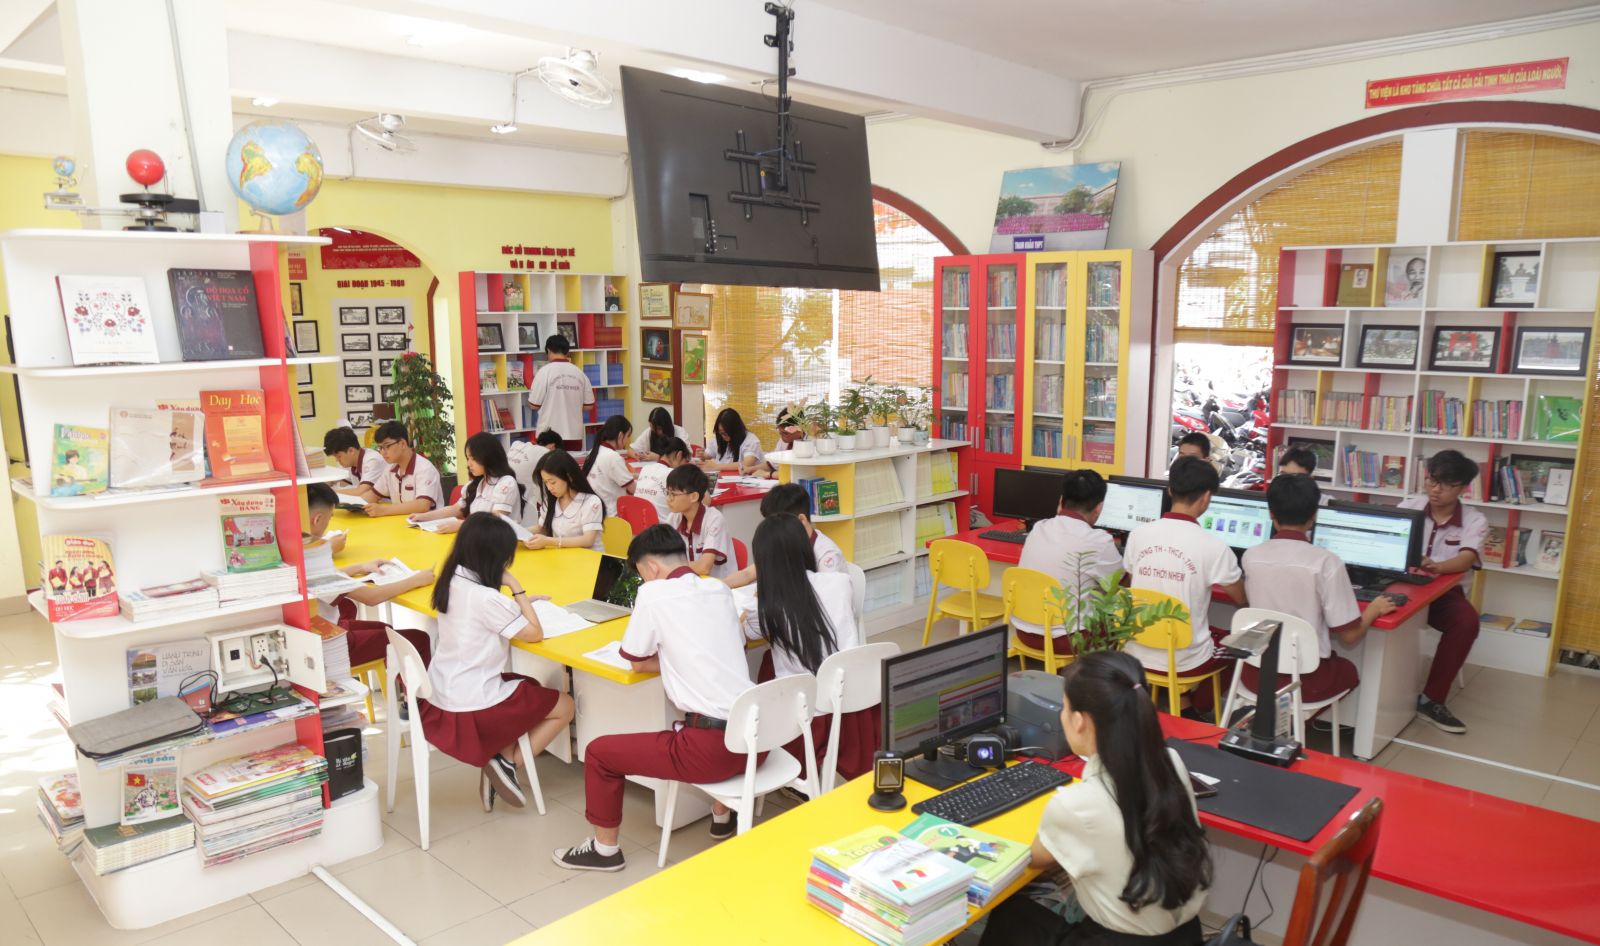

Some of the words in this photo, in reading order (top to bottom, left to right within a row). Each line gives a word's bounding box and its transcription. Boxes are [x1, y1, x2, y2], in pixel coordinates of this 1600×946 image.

[1154, 545, 1163, 553] TH
[1168, 546, 1184, 559] THCS
[1138, 565, 1152, 577] NGÔ
